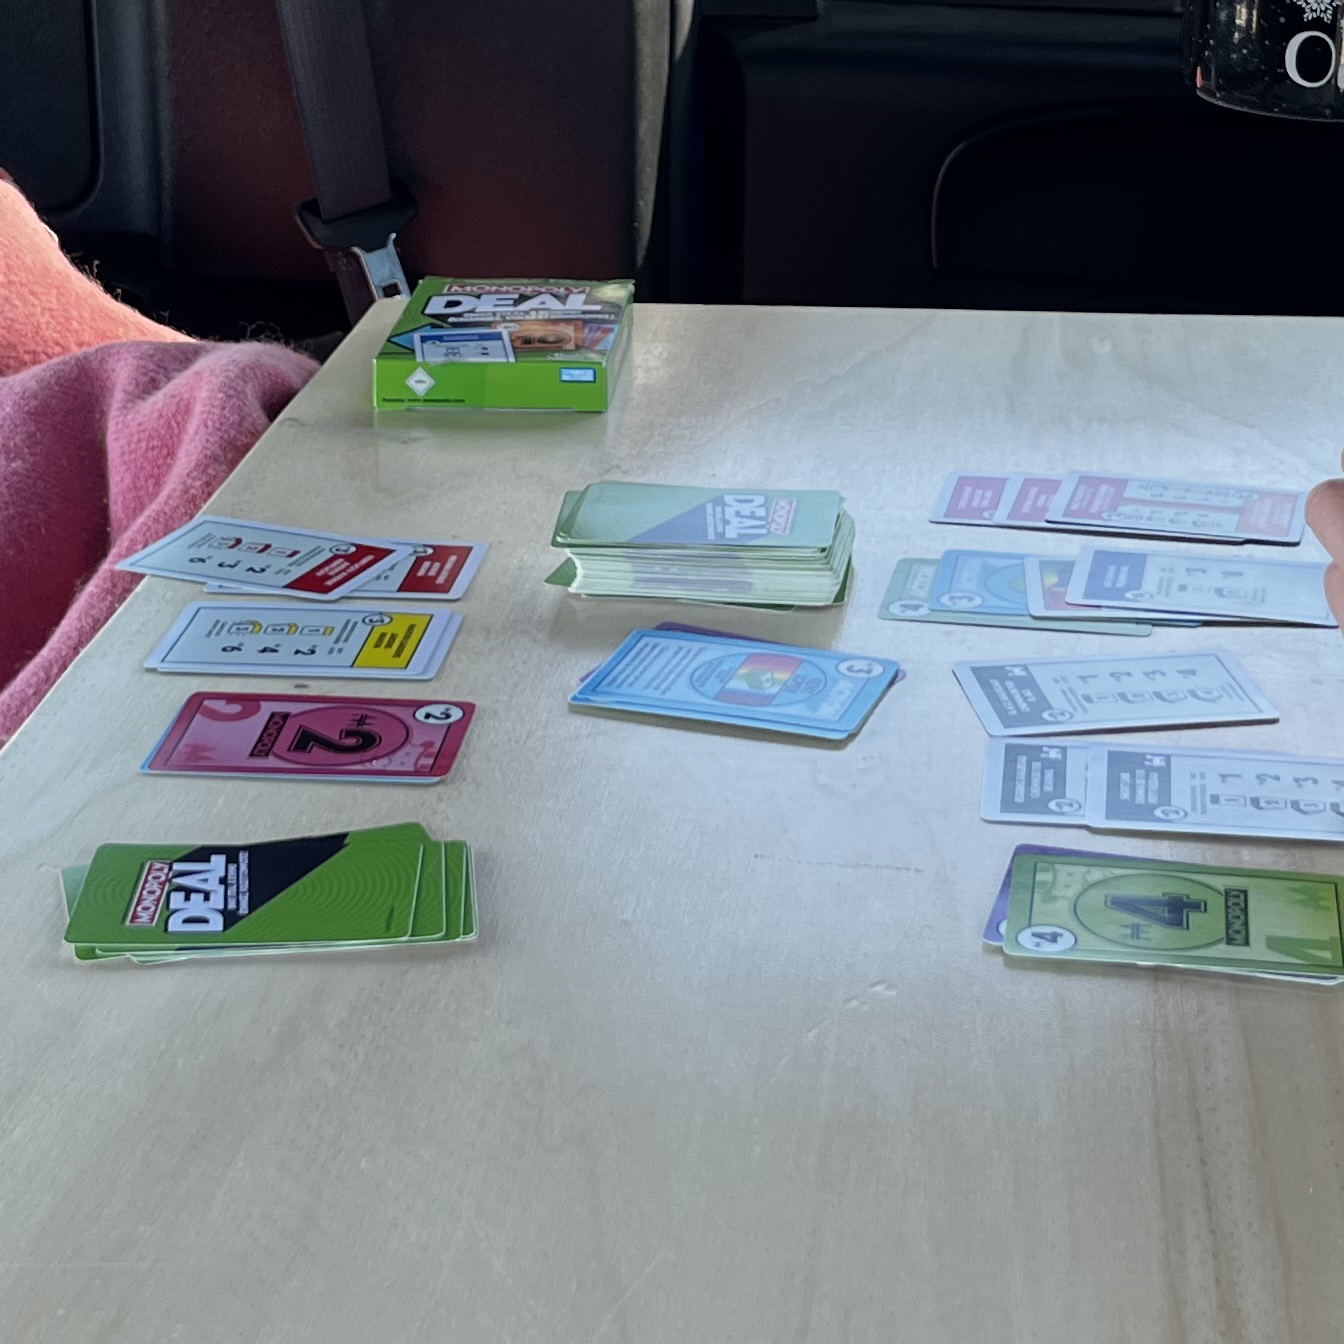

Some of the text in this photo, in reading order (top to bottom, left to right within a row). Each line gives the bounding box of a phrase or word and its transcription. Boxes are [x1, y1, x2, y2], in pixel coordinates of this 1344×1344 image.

[424, 293, 603, 315] DEAL
[723, 494, 768, 539] DEAL
[423, 710, 452, 720] 2
[288, 725, 382, 754] 2
[131, 861, 169, 923] MONOPOLY
[167, 854, 226, 932] DEAL
[1105, 892, 1207, 930] 4
[1030, 931, 1064, 944] 4
